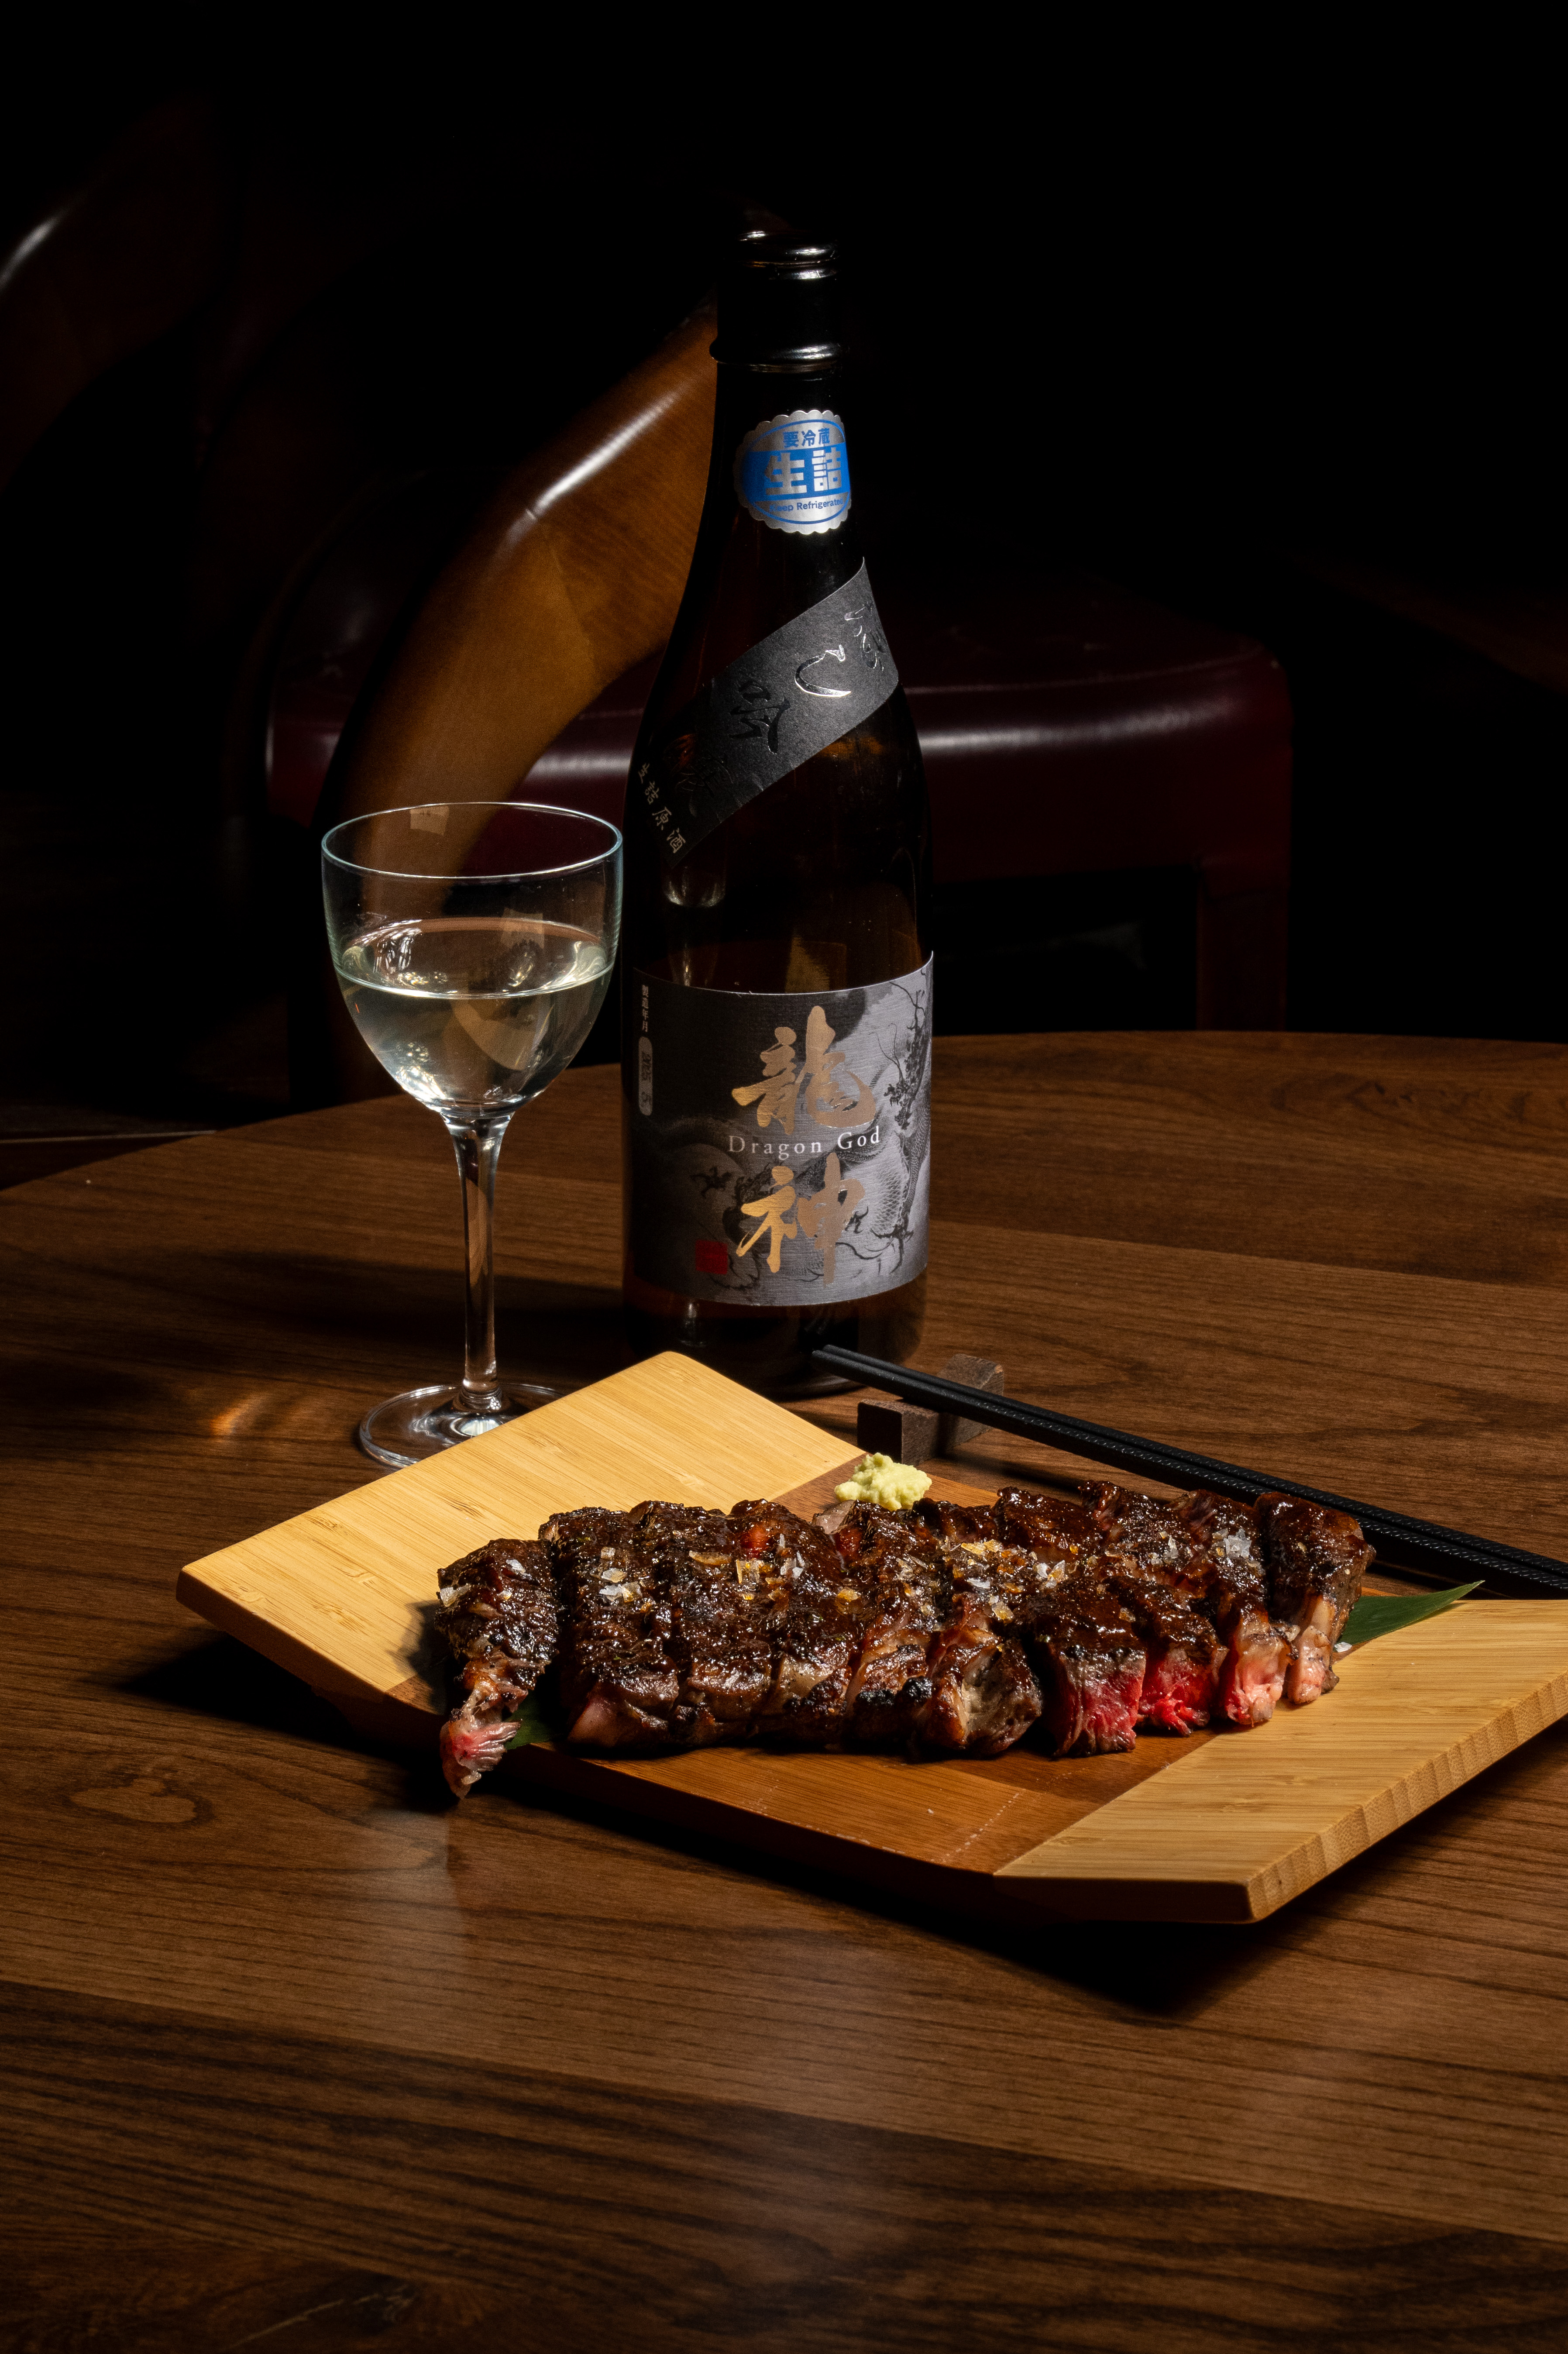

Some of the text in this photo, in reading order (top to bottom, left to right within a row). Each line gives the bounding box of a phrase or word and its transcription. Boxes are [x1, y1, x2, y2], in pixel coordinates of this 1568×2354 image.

[783, 427, 830, 448] 要冷蔵
[765, 447, 842, 496] 生詰
[769, 498, 843, 512] Keep Refrigerated
[638, 762, 686, 853] 生詰原酒
[729, 1125, 880, 1160] Dragon God
